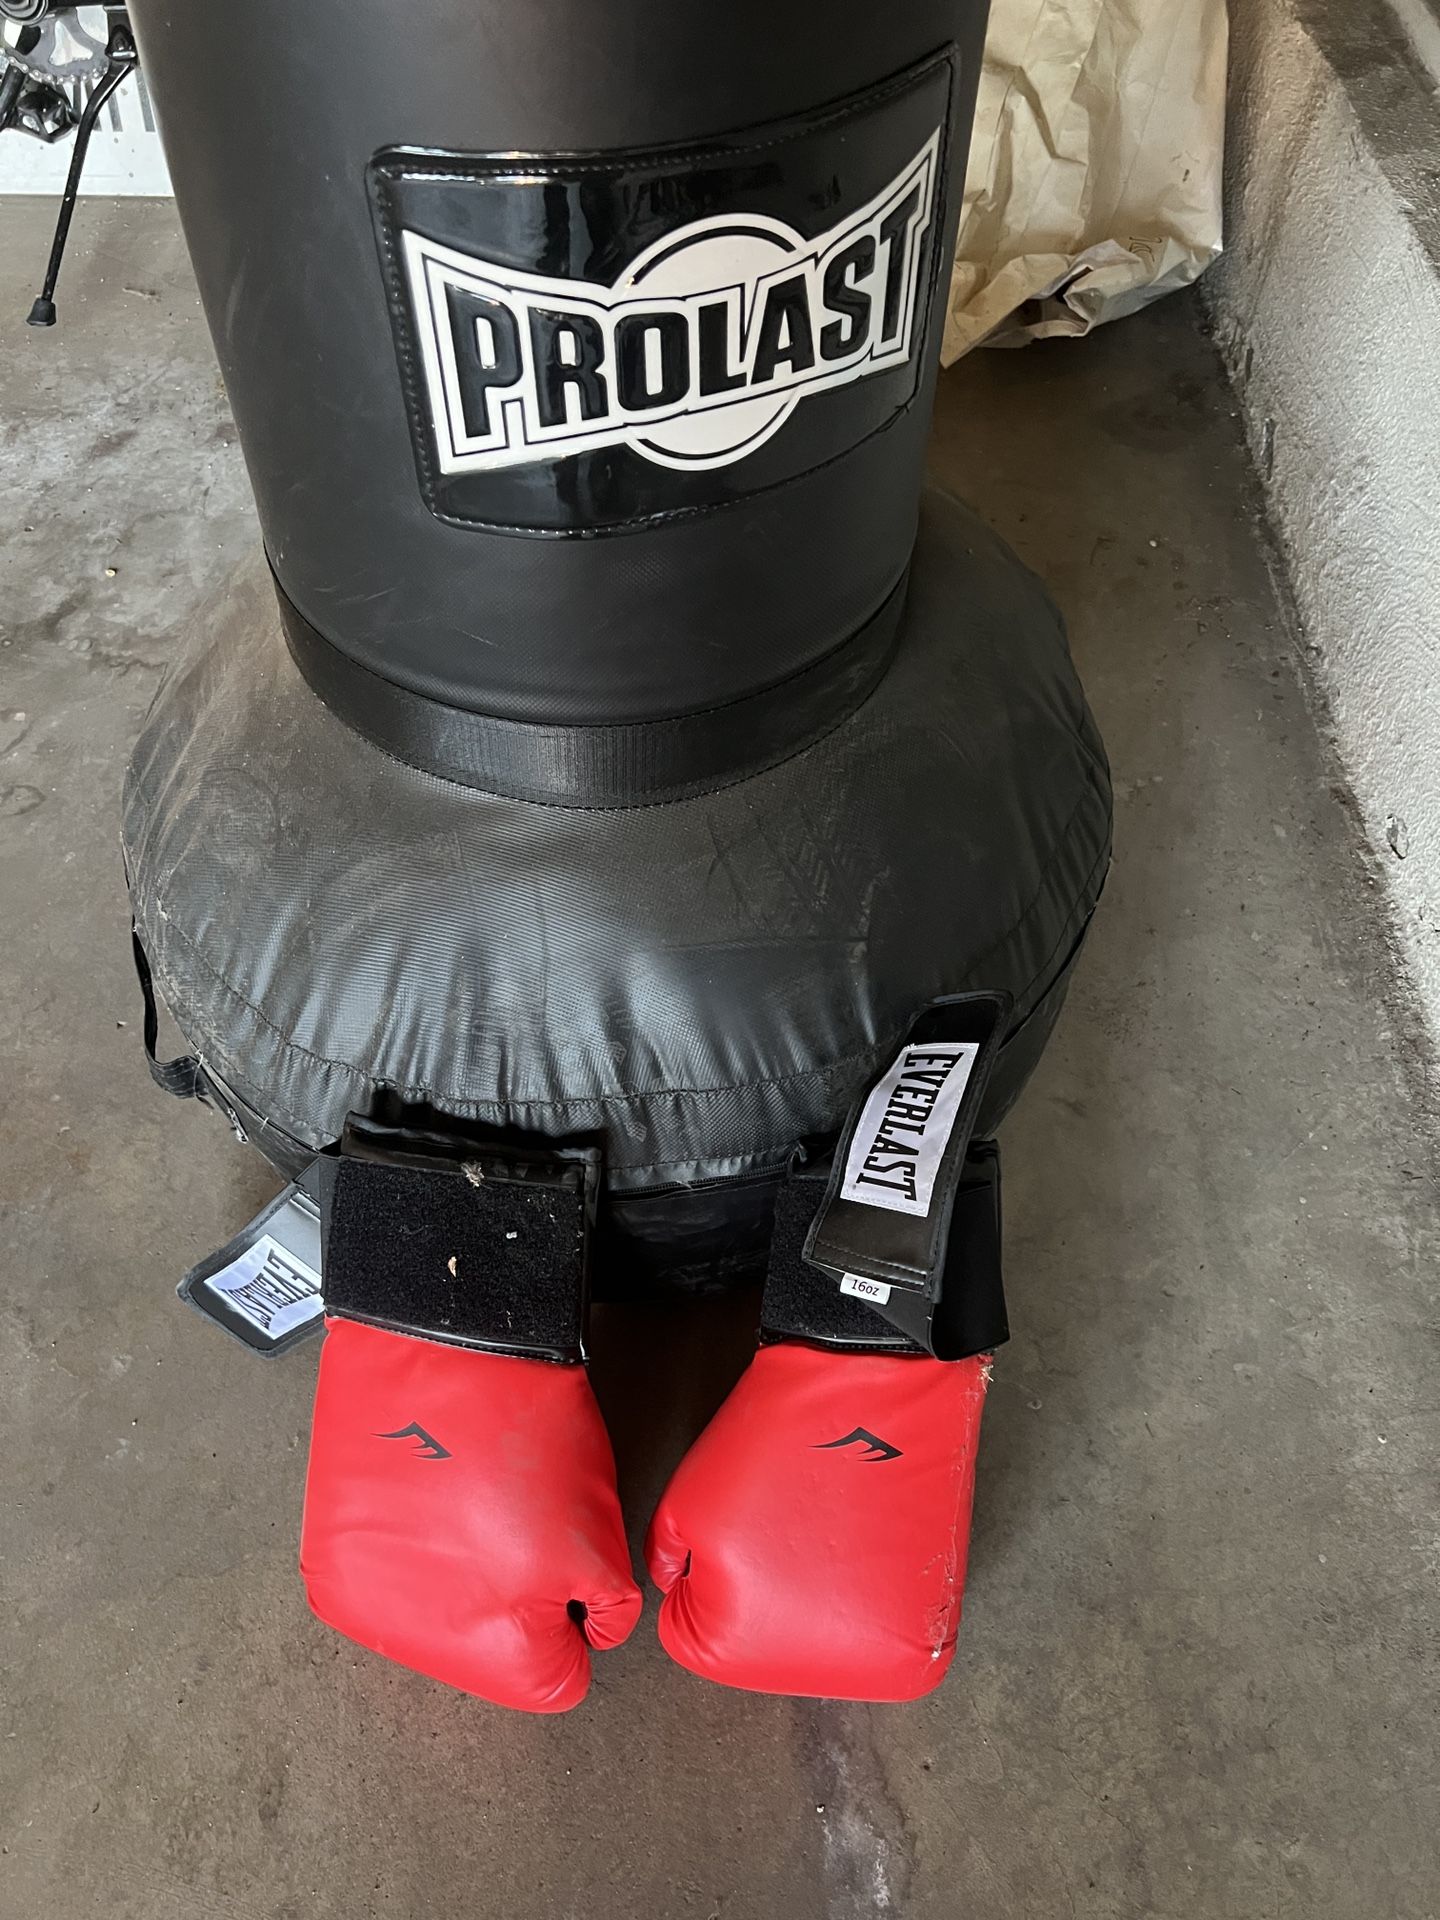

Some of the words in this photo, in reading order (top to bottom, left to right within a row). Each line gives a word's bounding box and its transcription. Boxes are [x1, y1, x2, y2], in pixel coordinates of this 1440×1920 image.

[443, 198, 922, 439] PROLAST
[855, 1051, 965, 1202] EVERLAST
[217, 1247, 323, 1331] EVERLAST
[850, 1279, 881, 1297] 16oz
